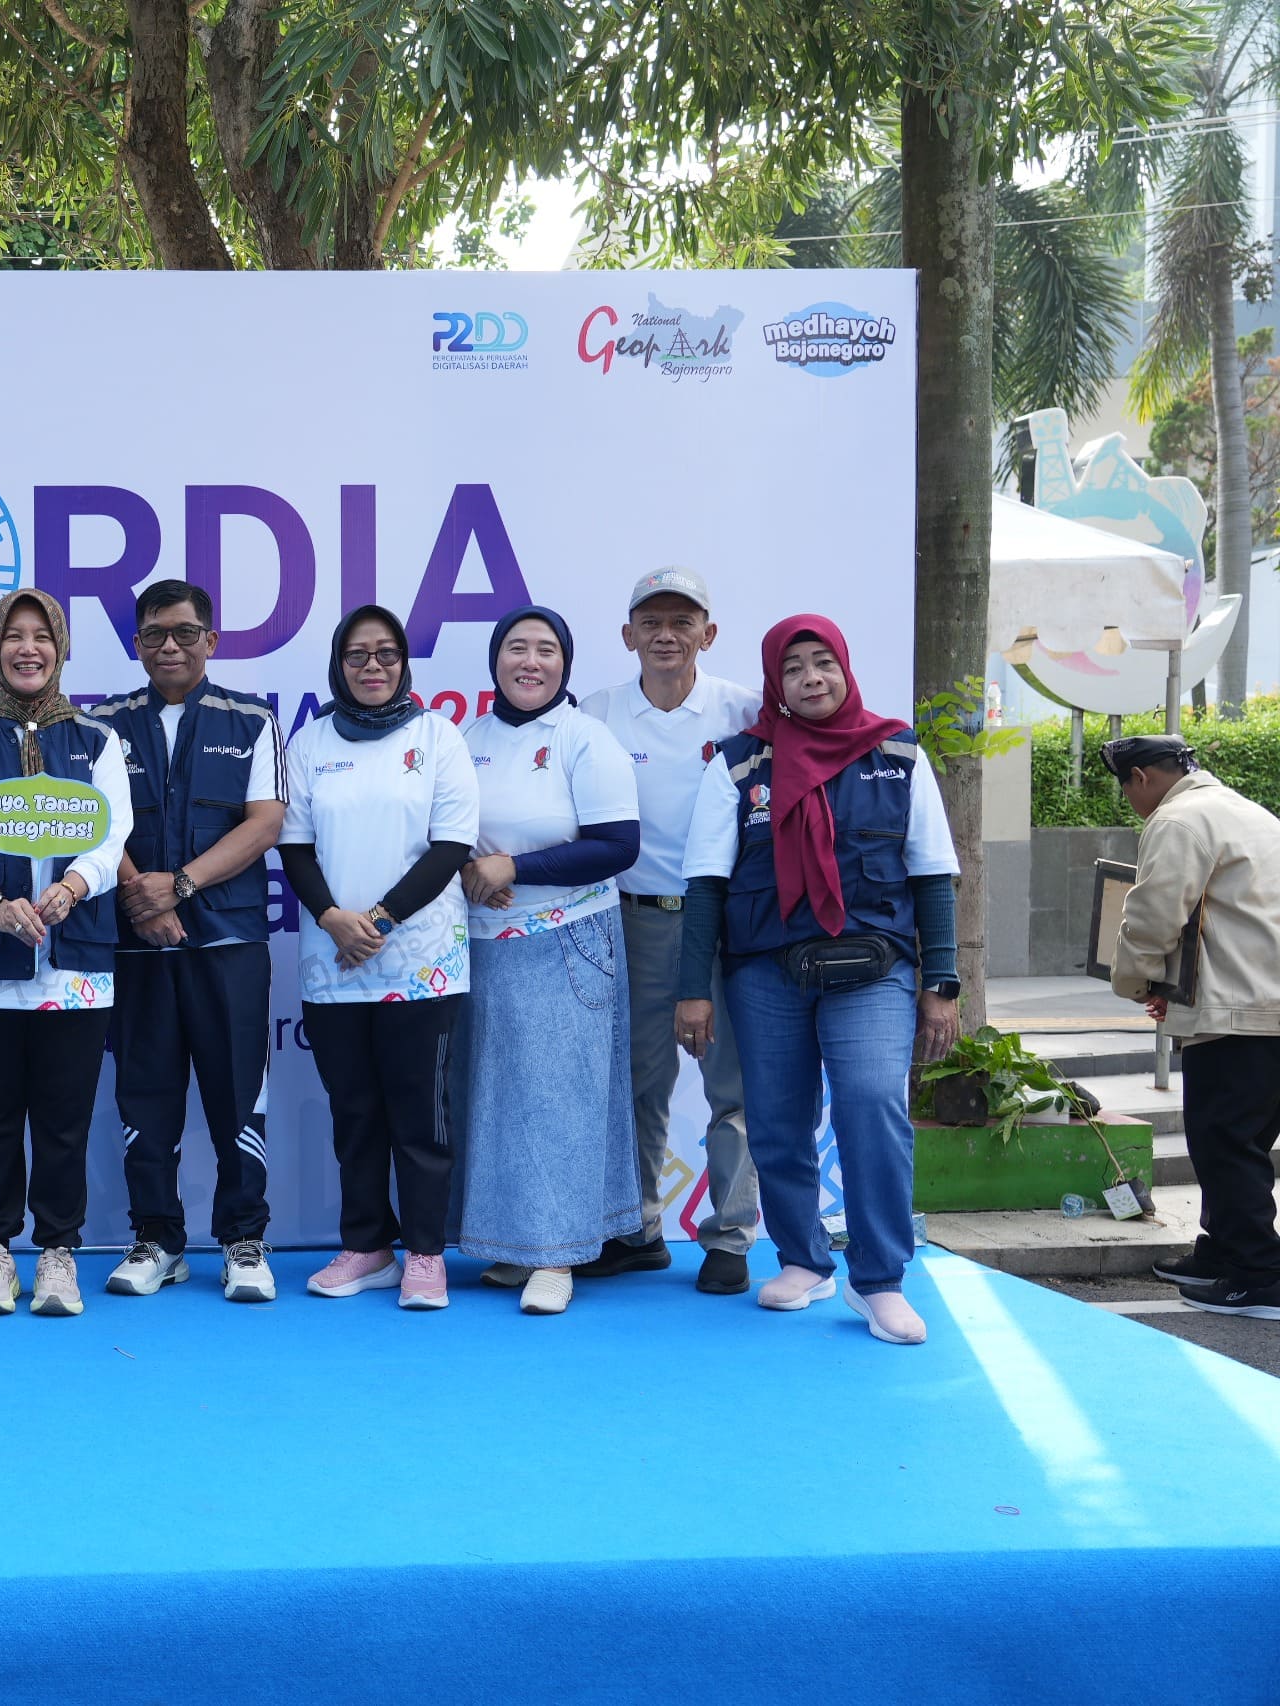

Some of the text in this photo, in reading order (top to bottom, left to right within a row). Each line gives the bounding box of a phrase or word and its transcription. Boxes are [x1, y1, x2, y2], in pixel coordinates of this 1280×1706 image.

[632, 312, 682, 327] National
[763, 313, 896, 345] medhayoh
[776, 339, 886, 366] Bojonegoro
[432, 361, 529, 370] DIGITALISASI DAERAH
[660, 361, 733, 384] Bojonegoro
[203, 745, 243, 758] bankjatim
[33, 794, 99, 814] Tanam
